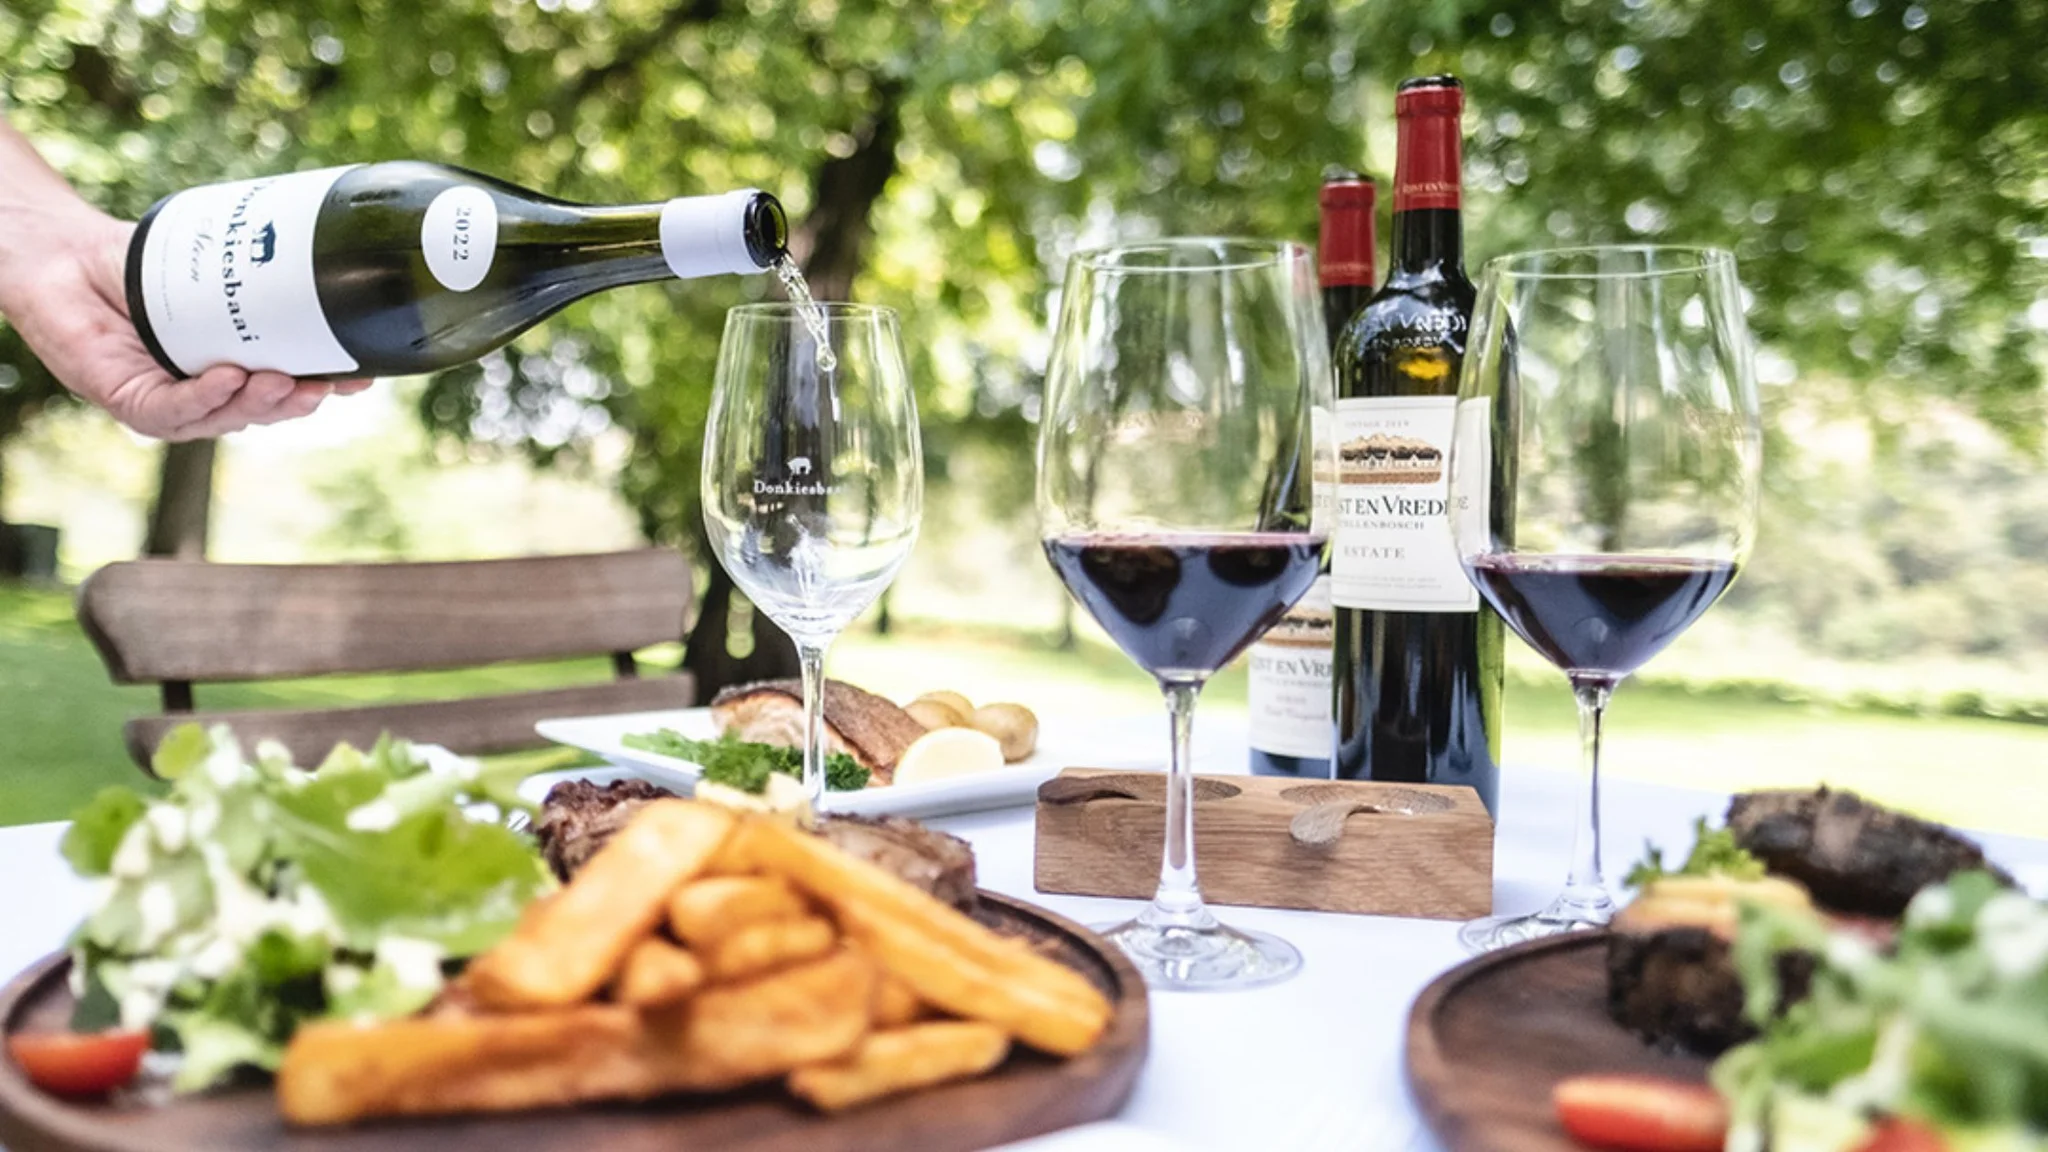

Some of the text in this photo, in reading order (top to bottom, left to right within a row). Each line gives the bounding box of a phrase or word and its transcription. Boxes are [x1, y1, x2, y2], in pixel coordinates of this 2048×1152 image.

[453, 206, 472, 261] 2022
[753, 480, 844, 495] Donkiesbaa
[1355, 499, 1378, 515] EN
[1338, 519, 1424, 530] TELLENBOSCH
[1344, 546, 1405, 558] ESTATE
